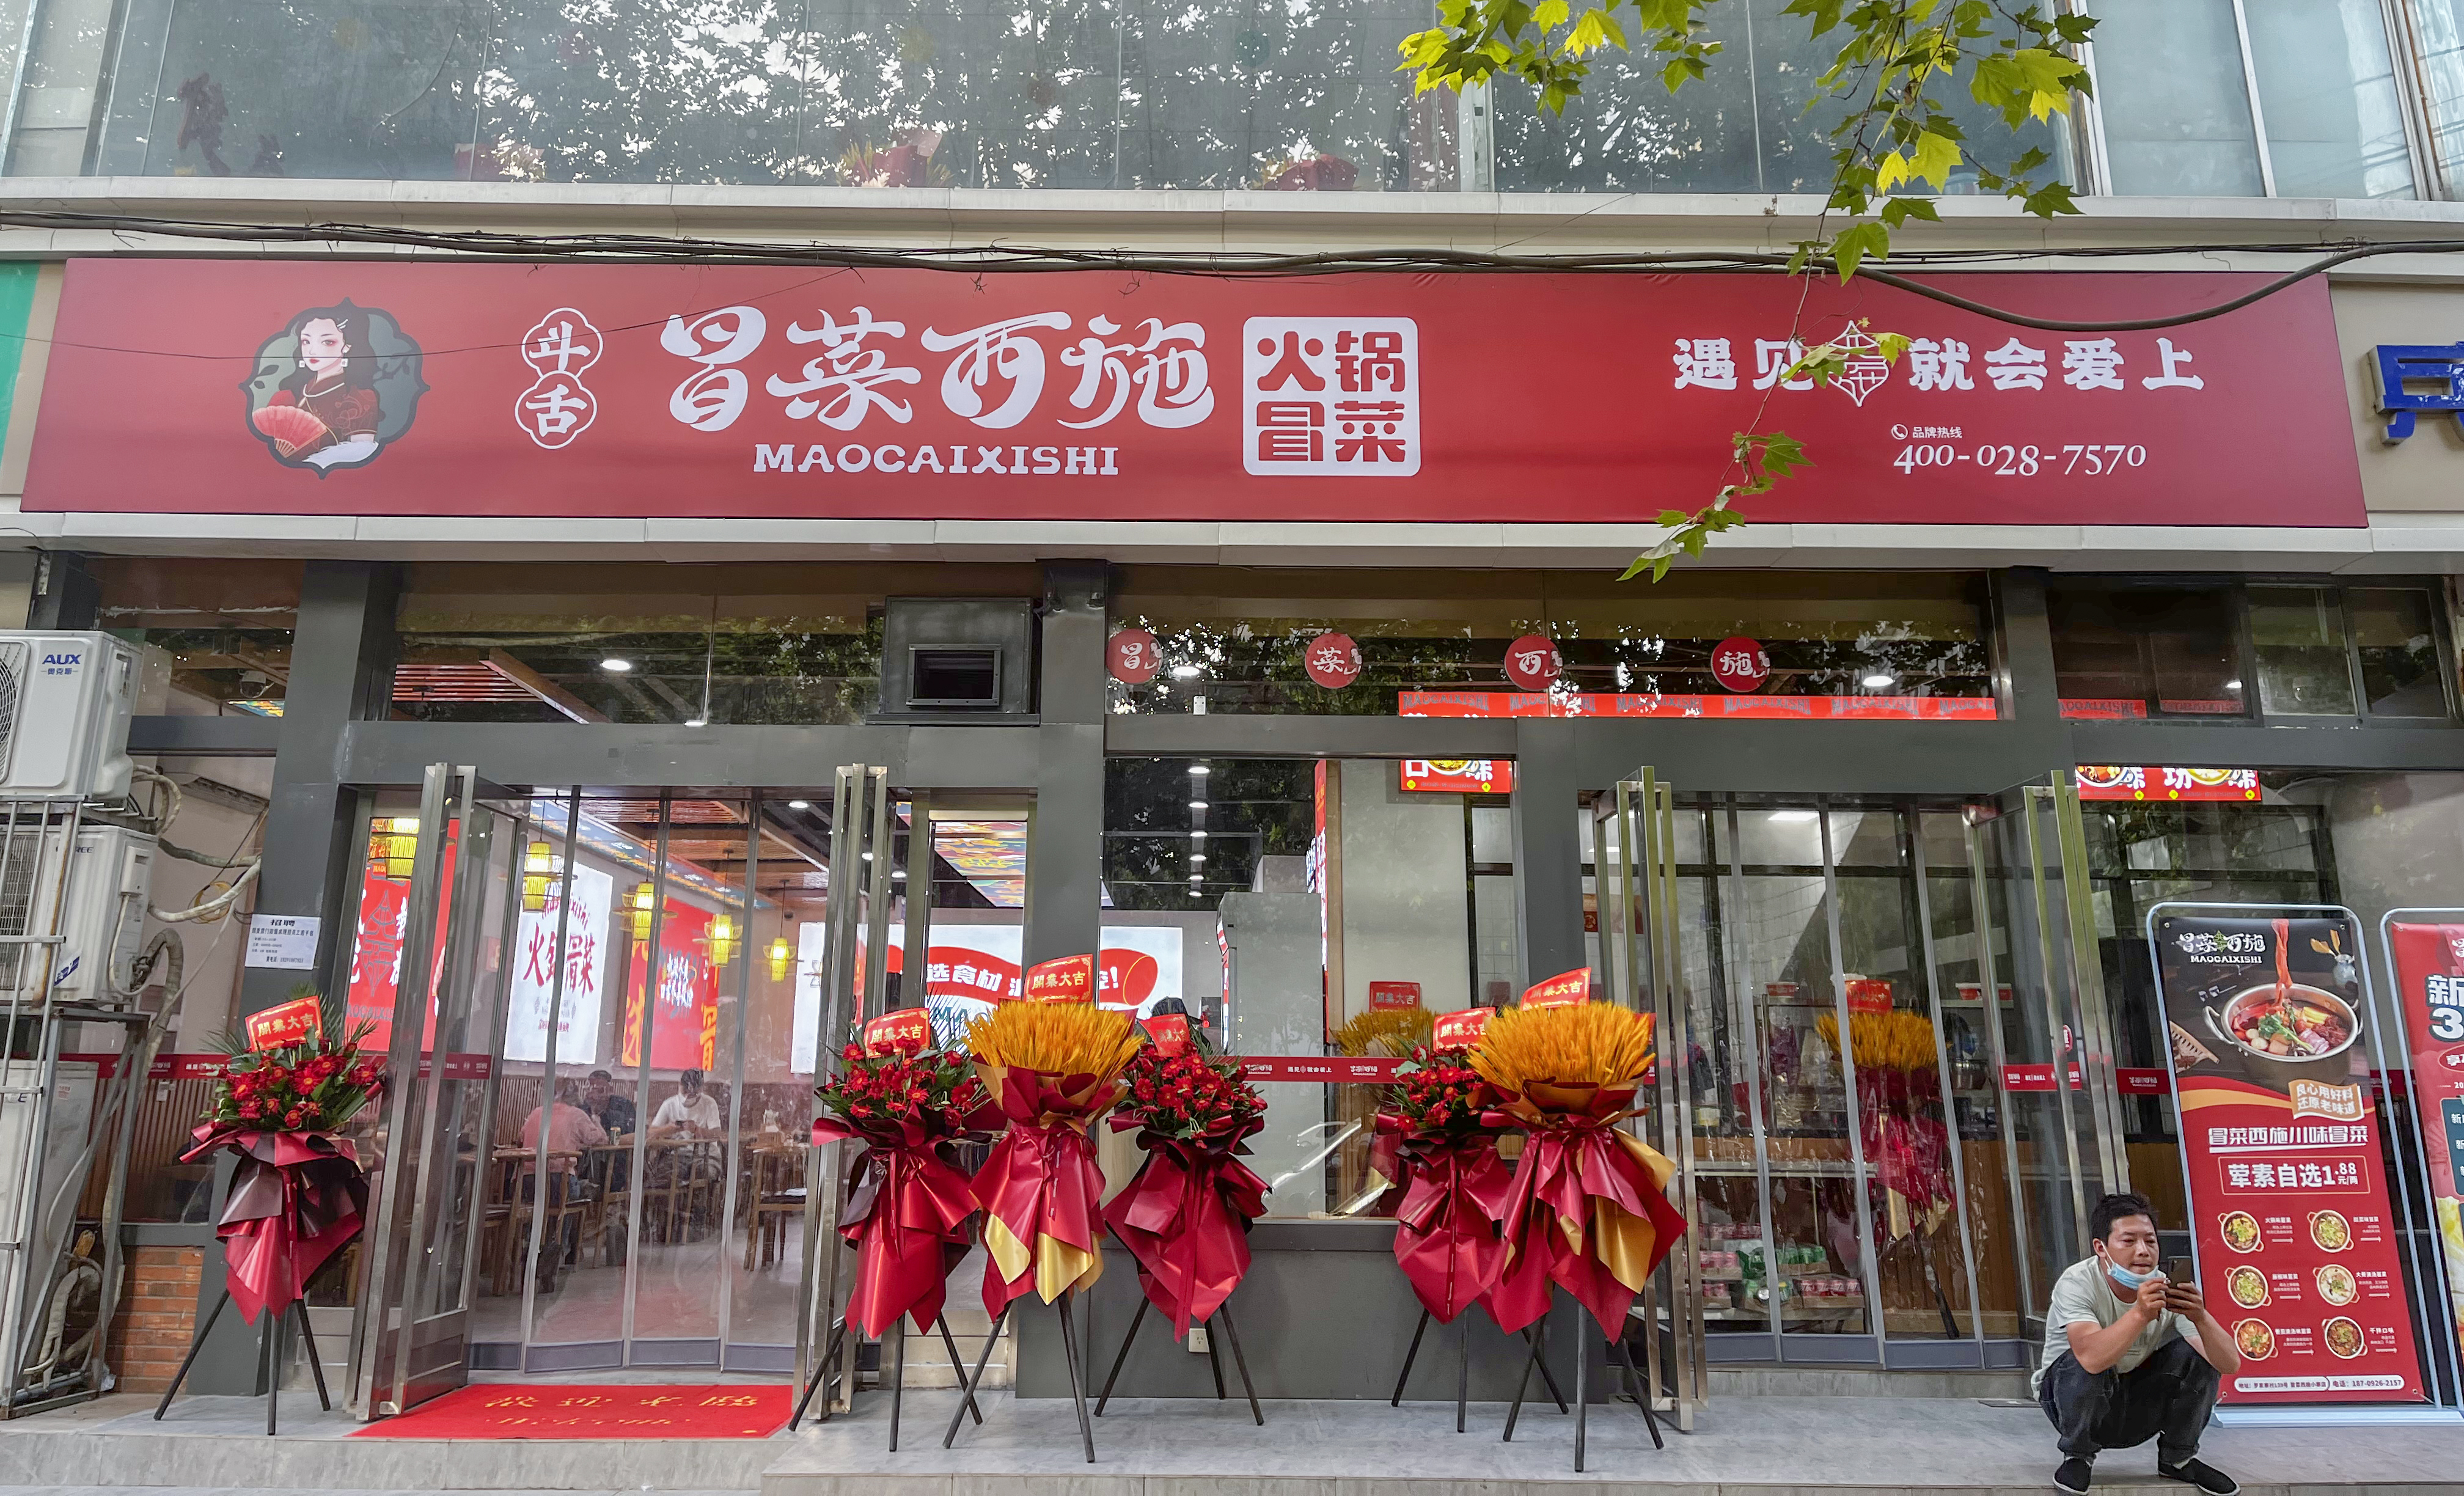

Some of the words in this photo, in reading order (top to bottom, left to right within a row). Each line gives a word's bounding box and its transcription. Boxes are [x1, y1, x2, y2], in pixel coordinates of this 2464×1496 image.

[661, 306, 1214, 432] 冒菜西施
[1256, 331, 1406, 392] 火锅
[1908, 337, 2204, 391] 就会爱上
[1256, 401, 1406, 463] 冒菜
[1912, 426, 1963, 439] 品牌热线
[754, 444, 1119, 475] MAOCAIXISHI
[1893, 444, 2146, 476] 400-028-7570
[42, 654, 82, 664] AUX
[1120, 642, 1143, 670] 冒
[1312, 647, 1344, 673] 菜
[1719, 651, 1754, 676] 施
[2179, 932, 2266, 953] 冒菜西施
[2190, 955, 2262, 964] MAOCAIXISHI
[1031, 970, 1086, 991] 開業大吉
[1529, 980, 1583, 999] 開業大吉
[1376, 991, 1416, 1005] 開業大吉
[257, 1013, 314, 1037] 開業大吉
[870, 1024, 923, 1044] 開業大吉
[2296, 1083, 2353, 1101] 良心用好料
[2297, 1096, 2356, 1115] 还原老味道
[2208, 1124, 2369, 1145] 冒菜西施川味冒菜
